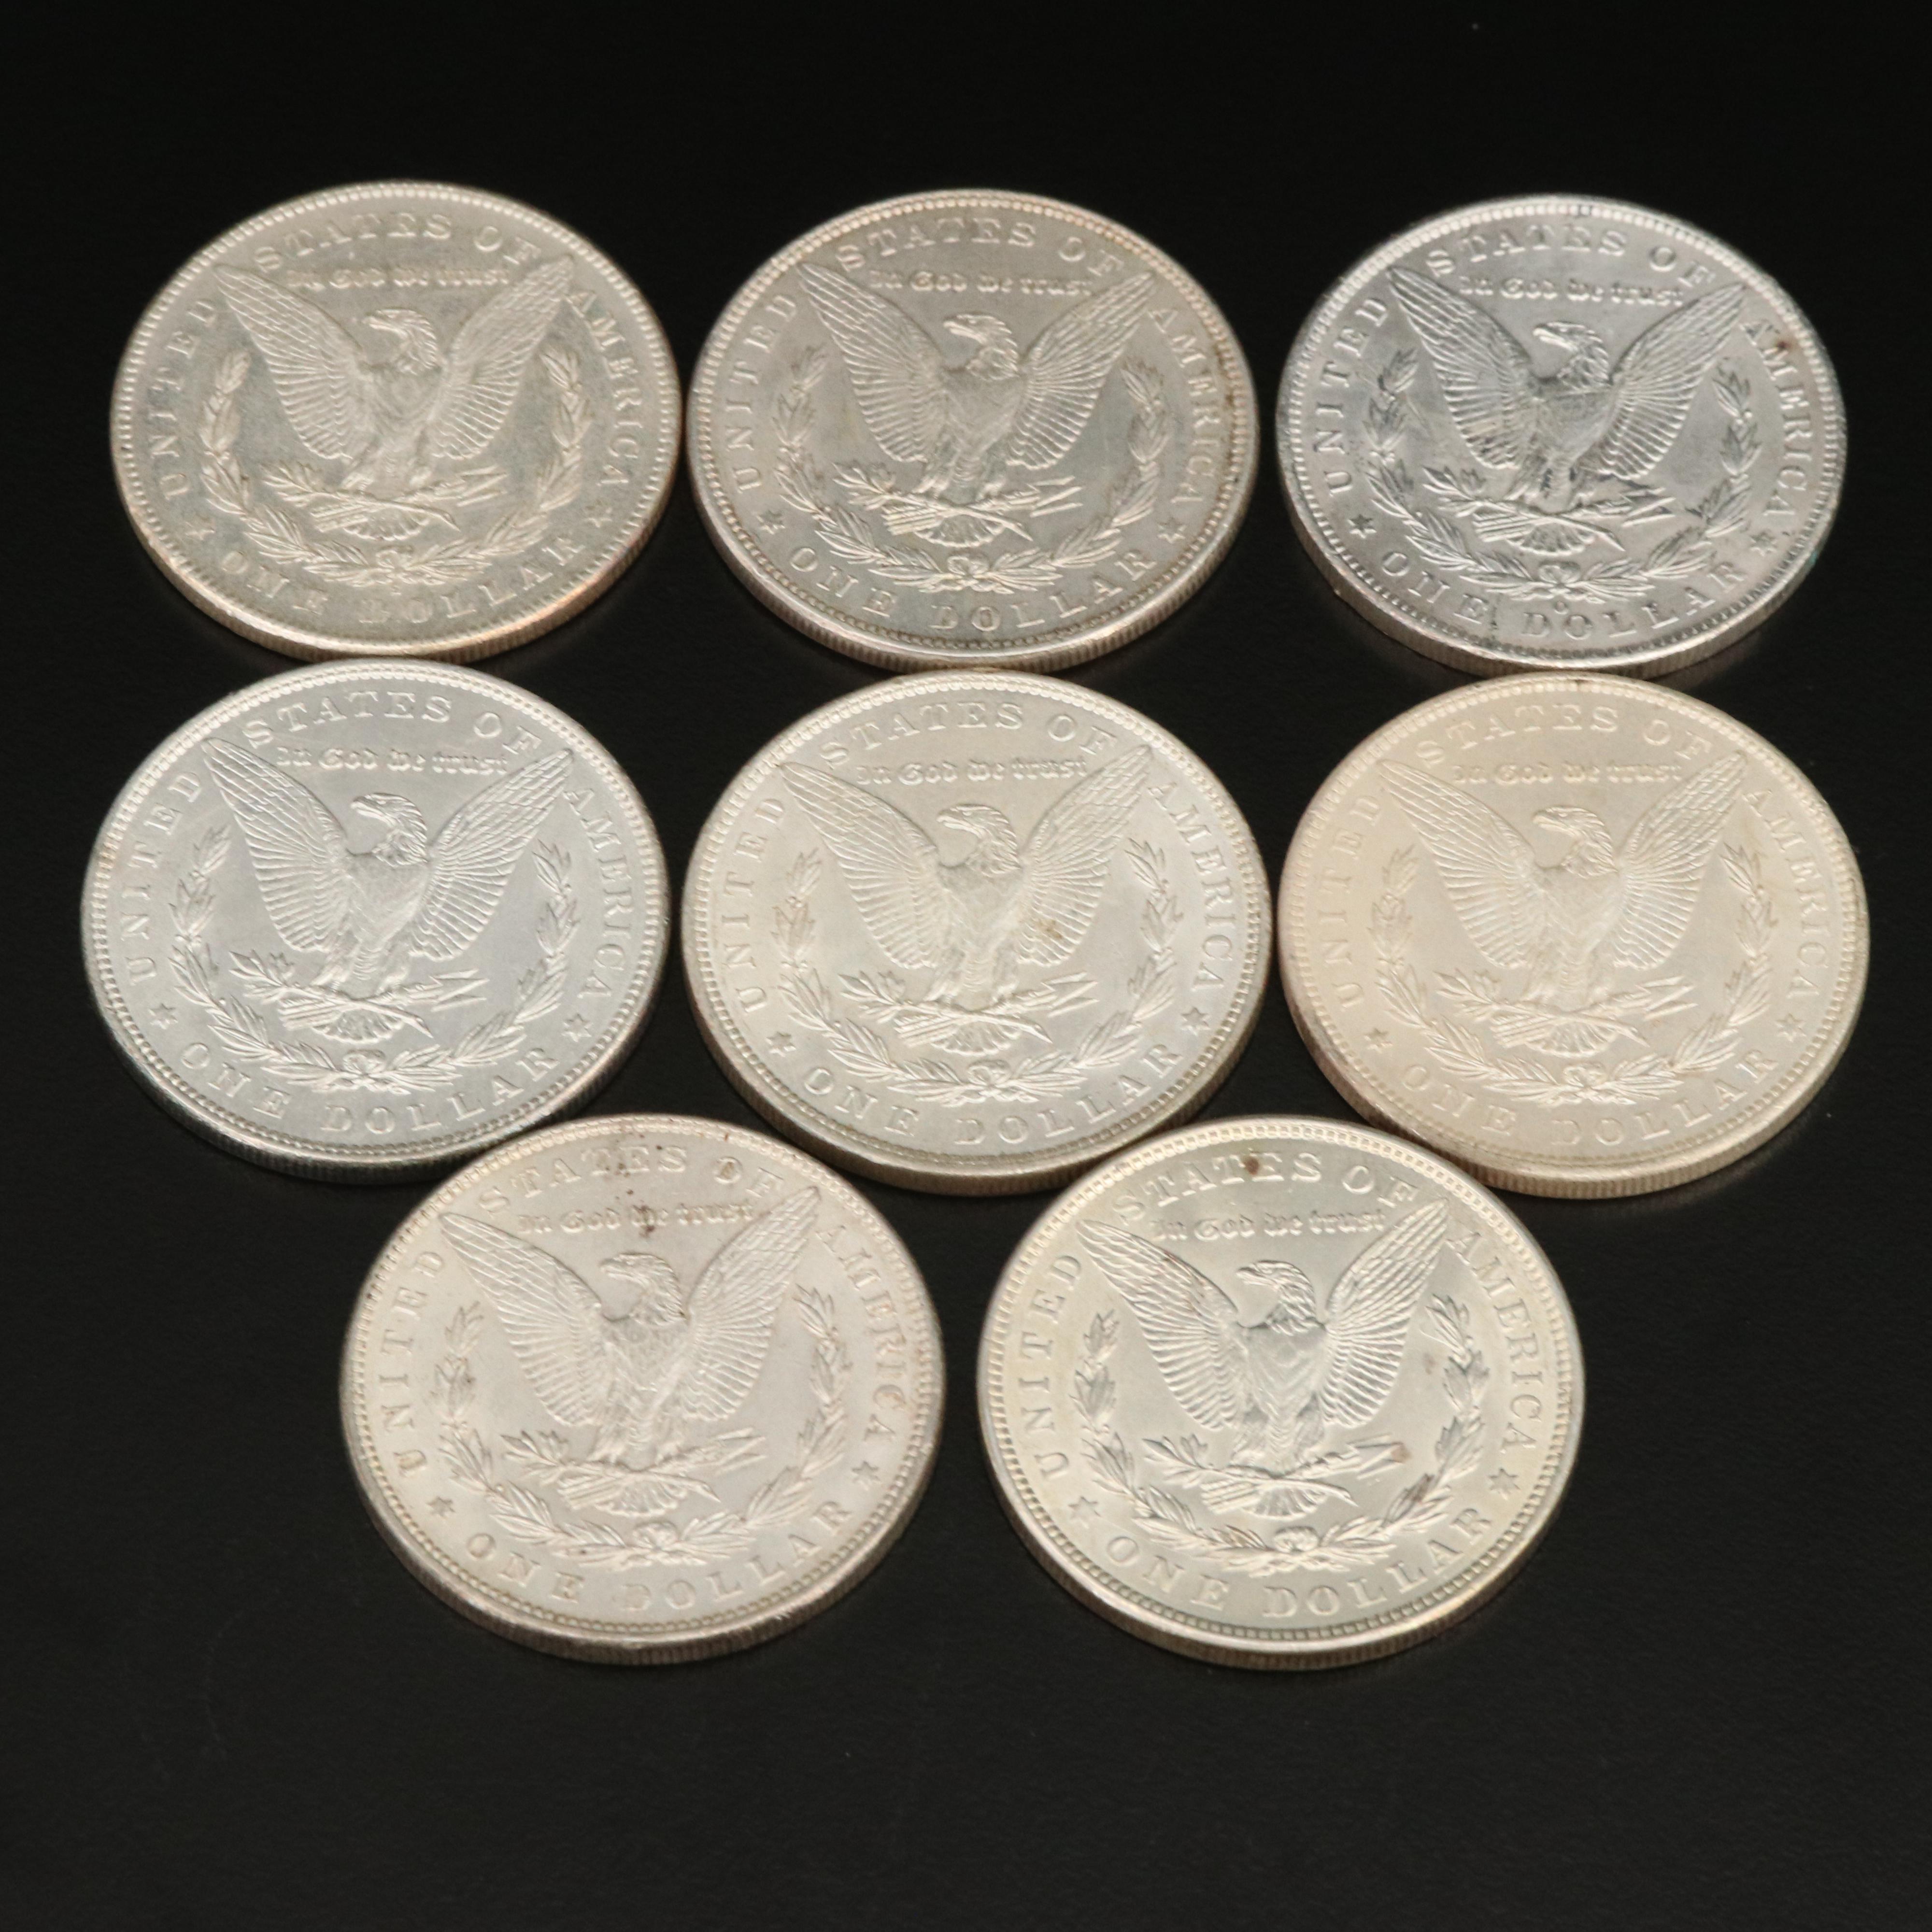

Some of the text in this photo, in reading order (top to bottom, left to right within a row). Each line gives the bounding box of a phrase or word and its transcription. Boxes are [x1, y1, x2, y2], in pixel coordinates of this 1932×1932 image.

[724, 217, 1222, 505] UNITED STATES OF AMERICA
[1314, 223, 1813, 520] UNITED STATES OF AMERICA
[791, 546, 1157, 633] ONE DOLLAR
[1380, 549, 1747, 641] ONE DOLLAR
[898, 759, 958, 784] God
[121, 691, 636, 1001] UNITED STATES OF AMERICA
[721, 701, 1236, 1013] UNITED STATES OF AMERICA
[1319, 705, 1830, 1010] UNITED STATES OF AMERICA
[180, 1042, 560, 1134] ONE DOLLAR
[803, 1044, 1184, 1146] ONE DOLLAR
[1400, 1047, 1779, 1147] ONE DOLLAR
[1193, 1215, 1254, 1241] God
[380, 1146, 908, 1478] UNITED STATES OF AMERICA
[1021, 1153, 1545, 1480] UNITED STATES OF AMERICA
[466, 1500, 854, 1611] ONE DOLLAR
[1108, 1507, 1494, 1618] ONE DOLLAR
